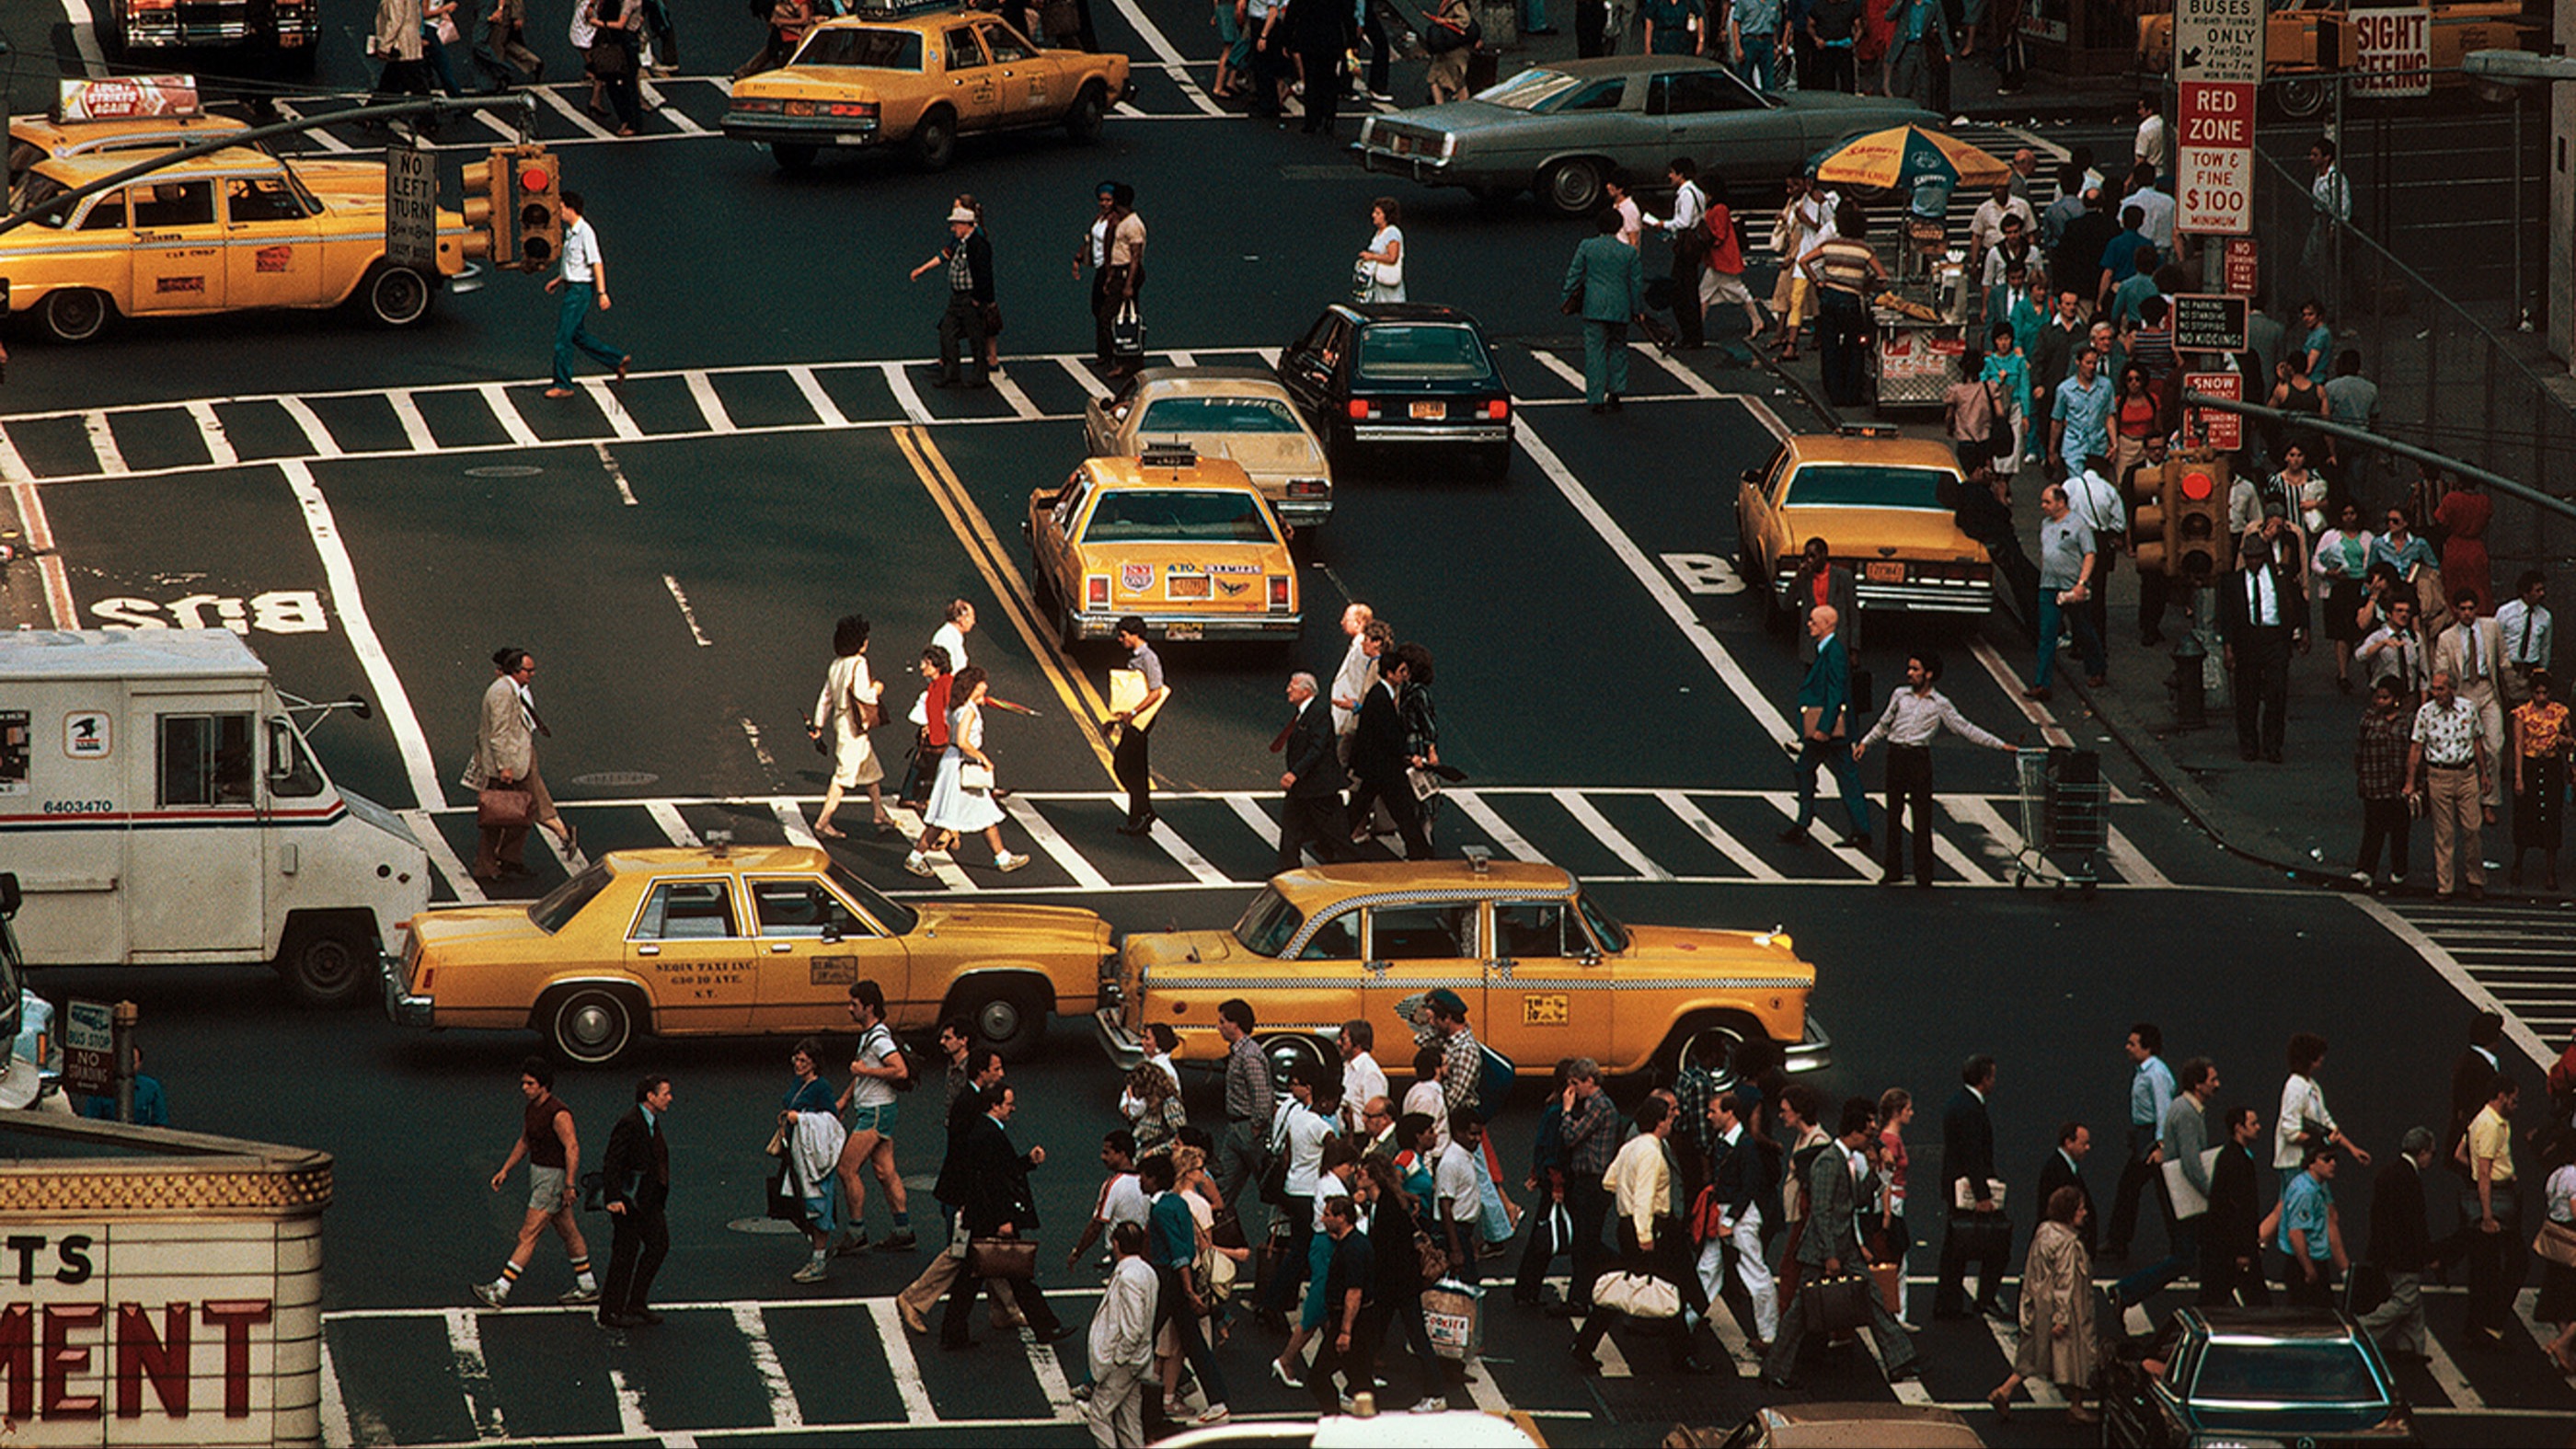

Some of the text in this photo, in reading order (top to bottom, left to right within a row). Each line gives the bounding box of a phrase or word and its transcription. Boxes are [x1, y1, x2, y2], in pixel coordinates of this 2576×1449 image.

[2191, 0, 2250, 15] BUSES
[2208, 29, 2255, 43] ONLY
[2356, 15, 2427, 50] SIGHT
[2353, 52, 2428, 89] SEEING
[2196, 90, 2237, 112] RED
[2189, 119, 2243, 141] ZONE
[399, 155, 422, 176] NO
[2192, 152, 2225, 167] TOW
[2196, 170, 2233, 186] FINE
[394, 177, 428, 199] LEFT
[2185, 188, 2244, 212] $100
[394, 197, 430, 221] TURN
[2191, 214, 2237, 227] MINIMUM
[2234, 242, 2250, 256] NO
[2179, 301, 2224, 311] NO PARKING
[2179, 311, 2190, 319] NO
[2179, 321, 2190, 330] NO
[2179, 332, 2194, 345] NO
[2193, 377, 2236, 390] SNOW
[43, 800, 112, 813] 6403470
[697, 962, 728, 972] TAXI
[68, 1029, 111, 1049] BUS STOP
[77, 1052, 99, 1067] NO
